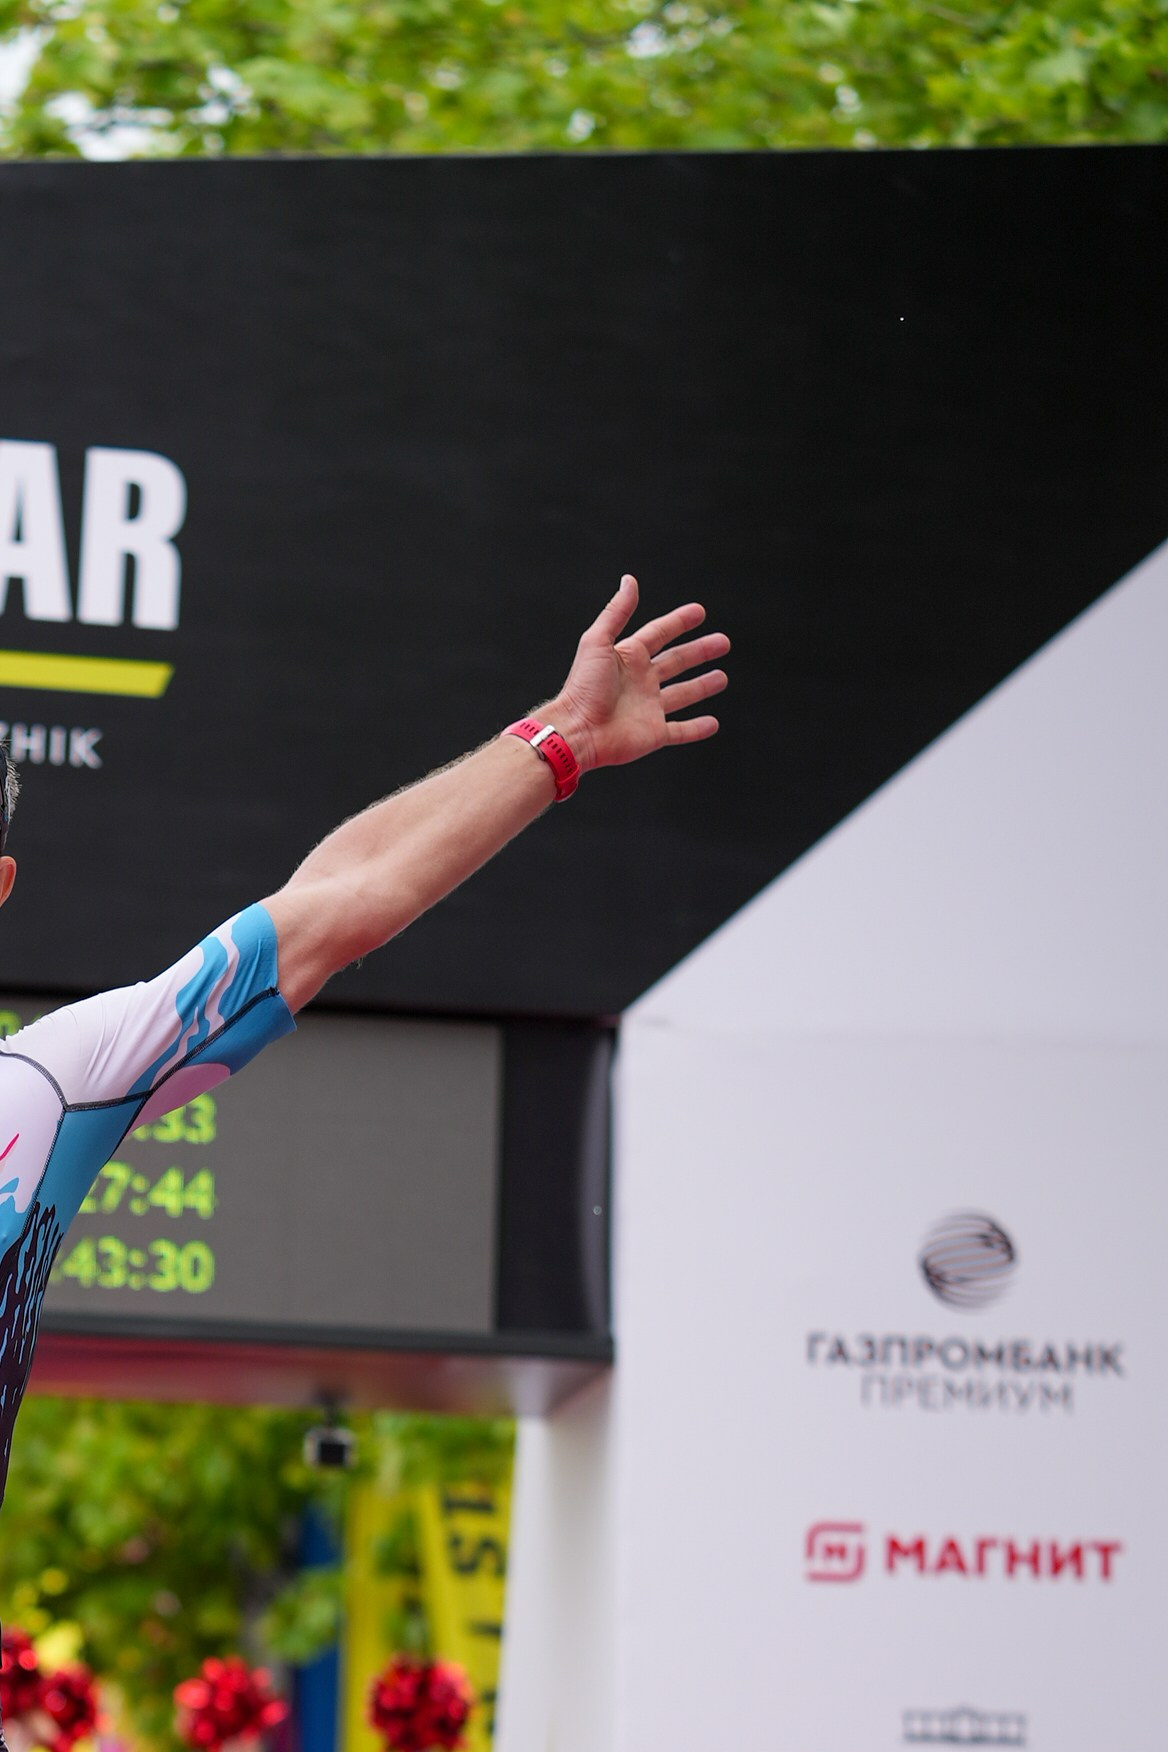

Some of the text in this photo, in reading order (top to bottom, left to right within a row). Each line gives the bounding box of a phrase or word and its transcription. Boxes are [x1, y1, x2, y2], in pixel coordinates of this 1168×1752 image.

[805, 1330, 1126, 1378] ГАЗПРОМБАНК
[860, 1373, 1075, 1415] ПРЕМИУМ
[885, 1532, 1123, 1583] МАГНИТ
